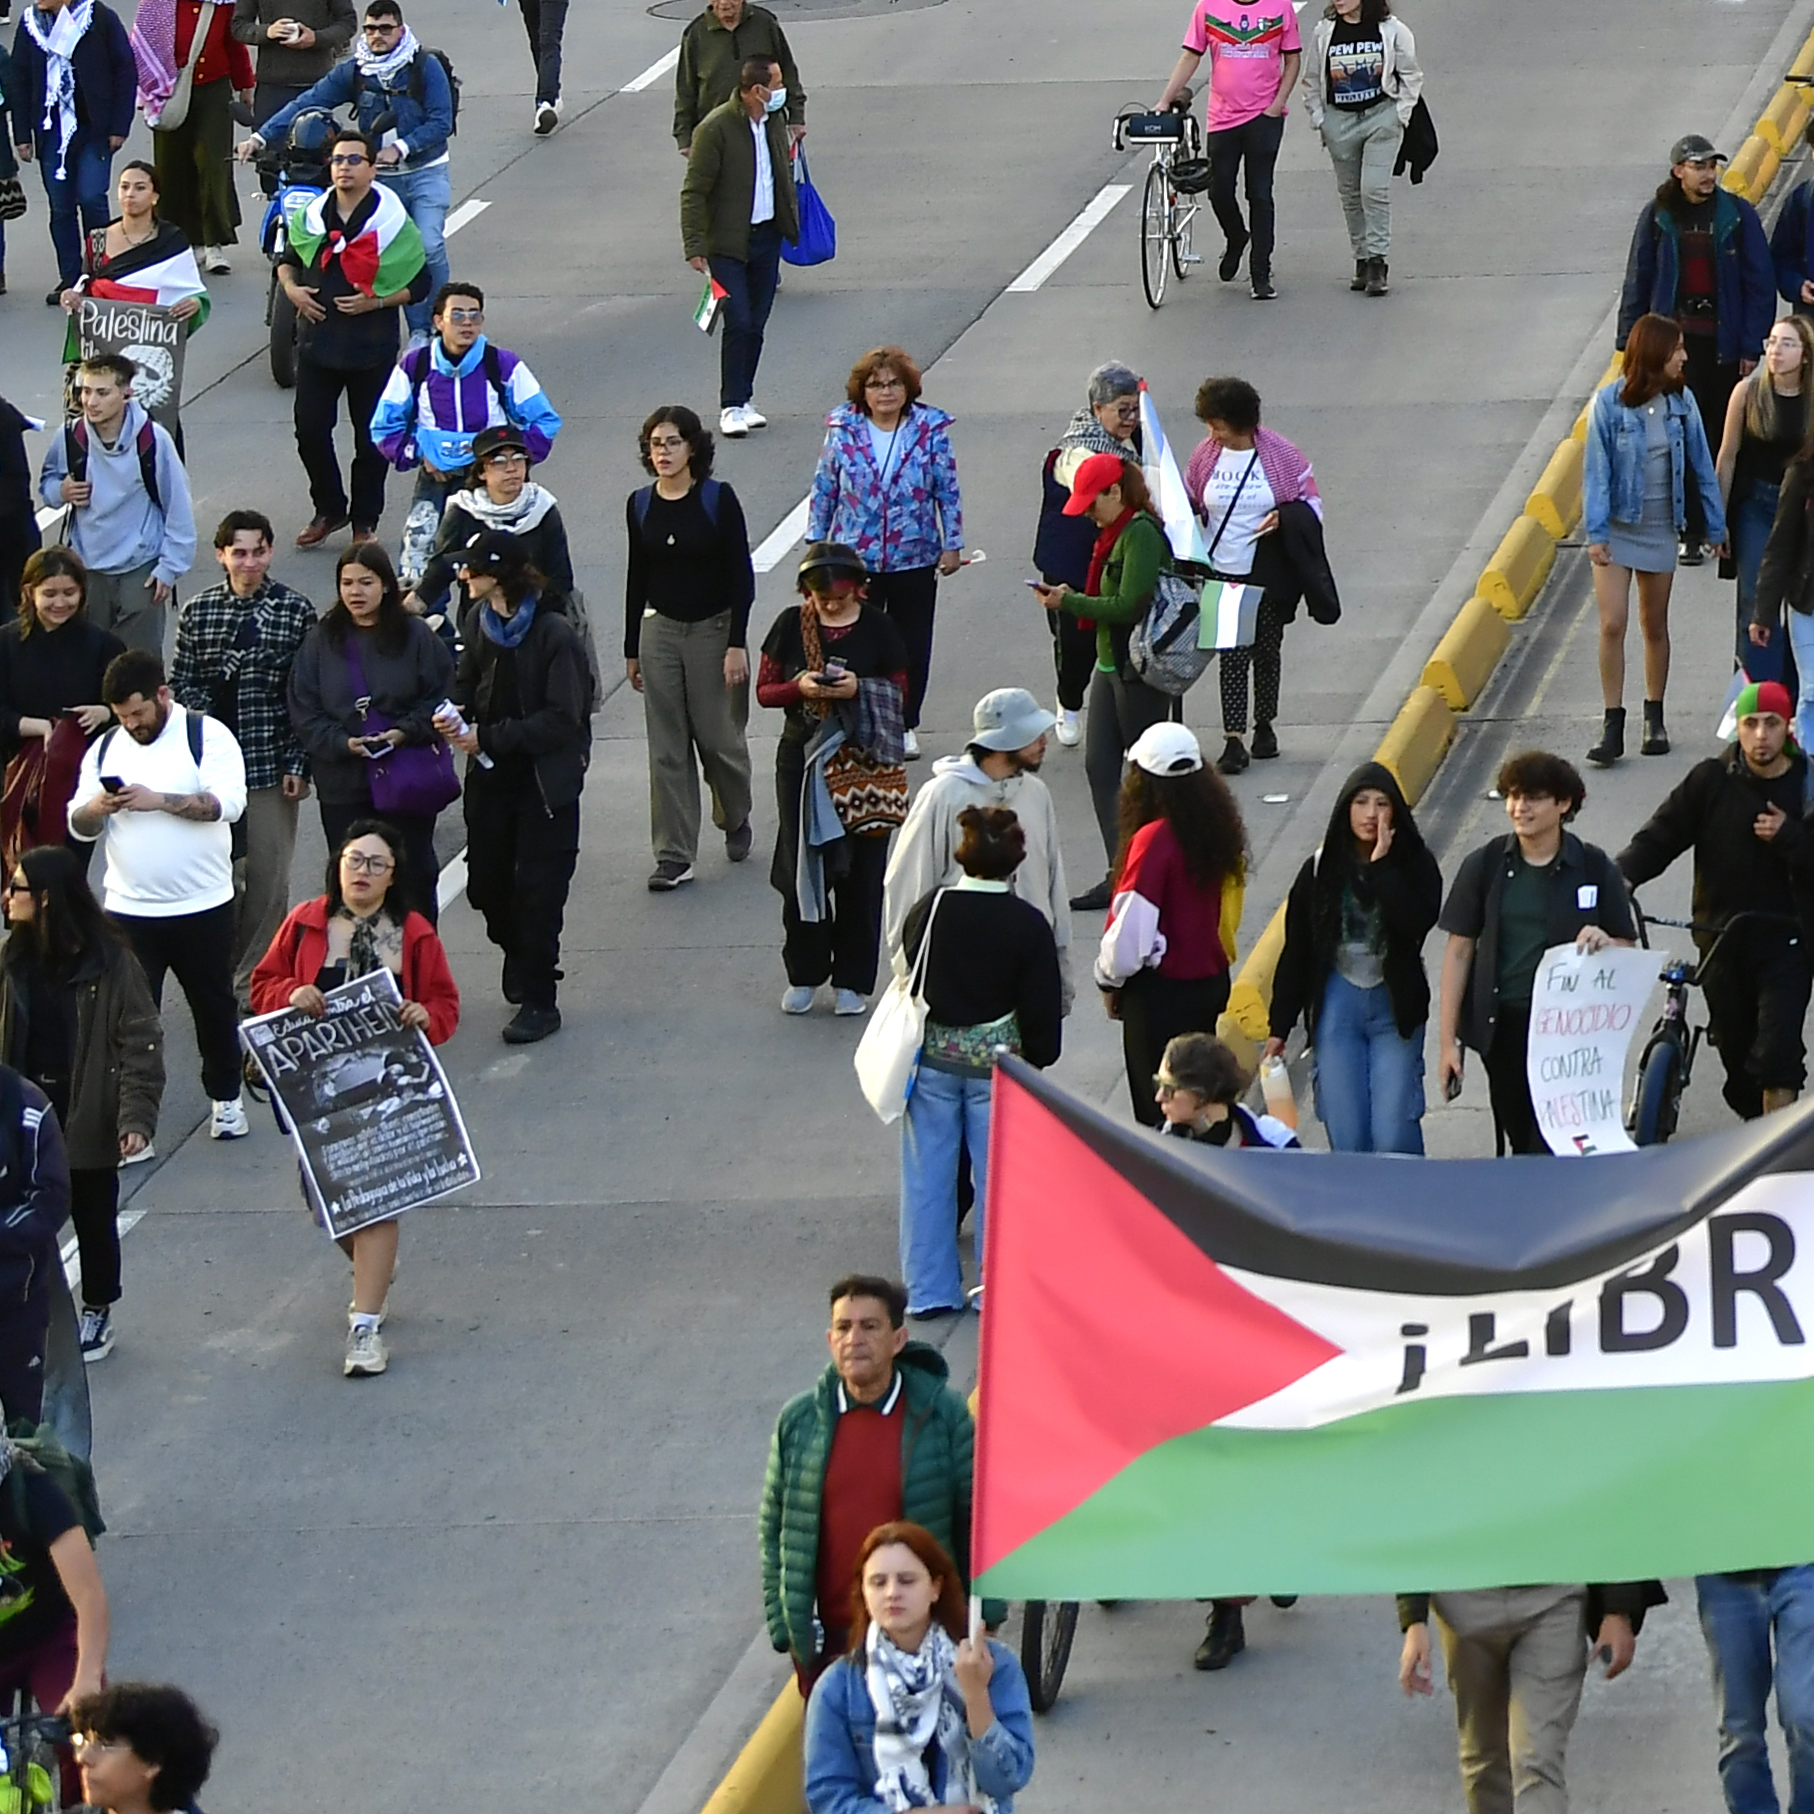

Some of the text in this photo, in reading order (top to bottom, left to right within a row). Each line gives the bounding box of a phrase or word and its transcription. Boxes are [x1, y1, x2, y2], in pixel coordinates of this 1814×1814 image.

[1329, 39, 1383, 57] PEW PEW
[80, 298, 179, 346] Palestina
[1547, 962, 1616, 993] FIN AL
[1534, 1003, 1632, 1037] GENOCIDIO
[265, 999, 407, 1079] APARTHEID
[1541, 1046, 1603, 1083] CONTRA
